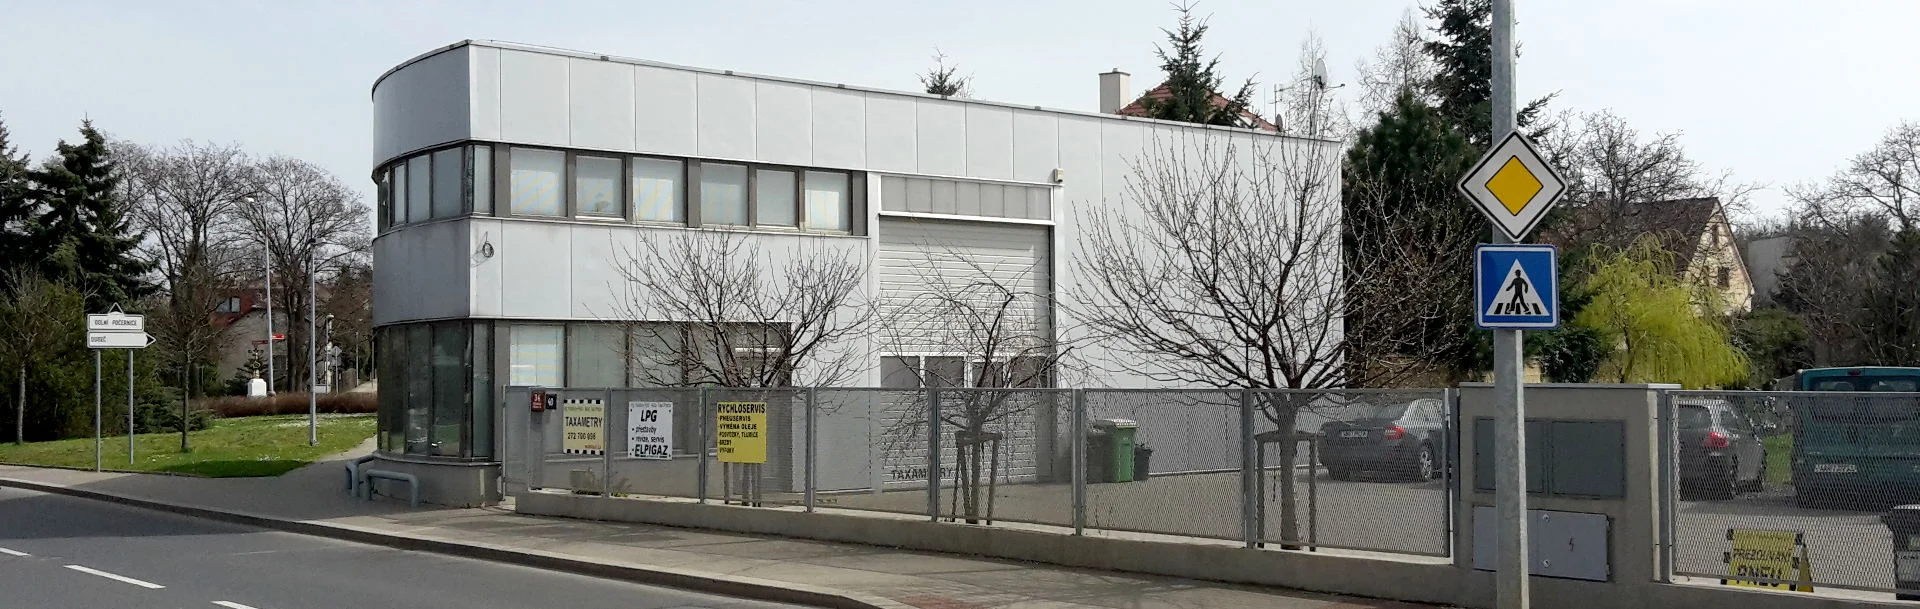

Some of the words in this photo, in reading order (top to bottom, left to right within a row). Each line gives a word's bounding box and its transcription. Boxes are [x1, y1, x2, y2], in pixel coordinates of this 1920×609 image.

[717, 403, 766, 414] RYCHLOSERVIS
[565, 416, 603, 428] TAXAMETRY
[640, 409, 658, 422] LPG
[634, 443, 668, 457] ELPIGAZ
[890, 467, 954, 480] TAXAMRY
